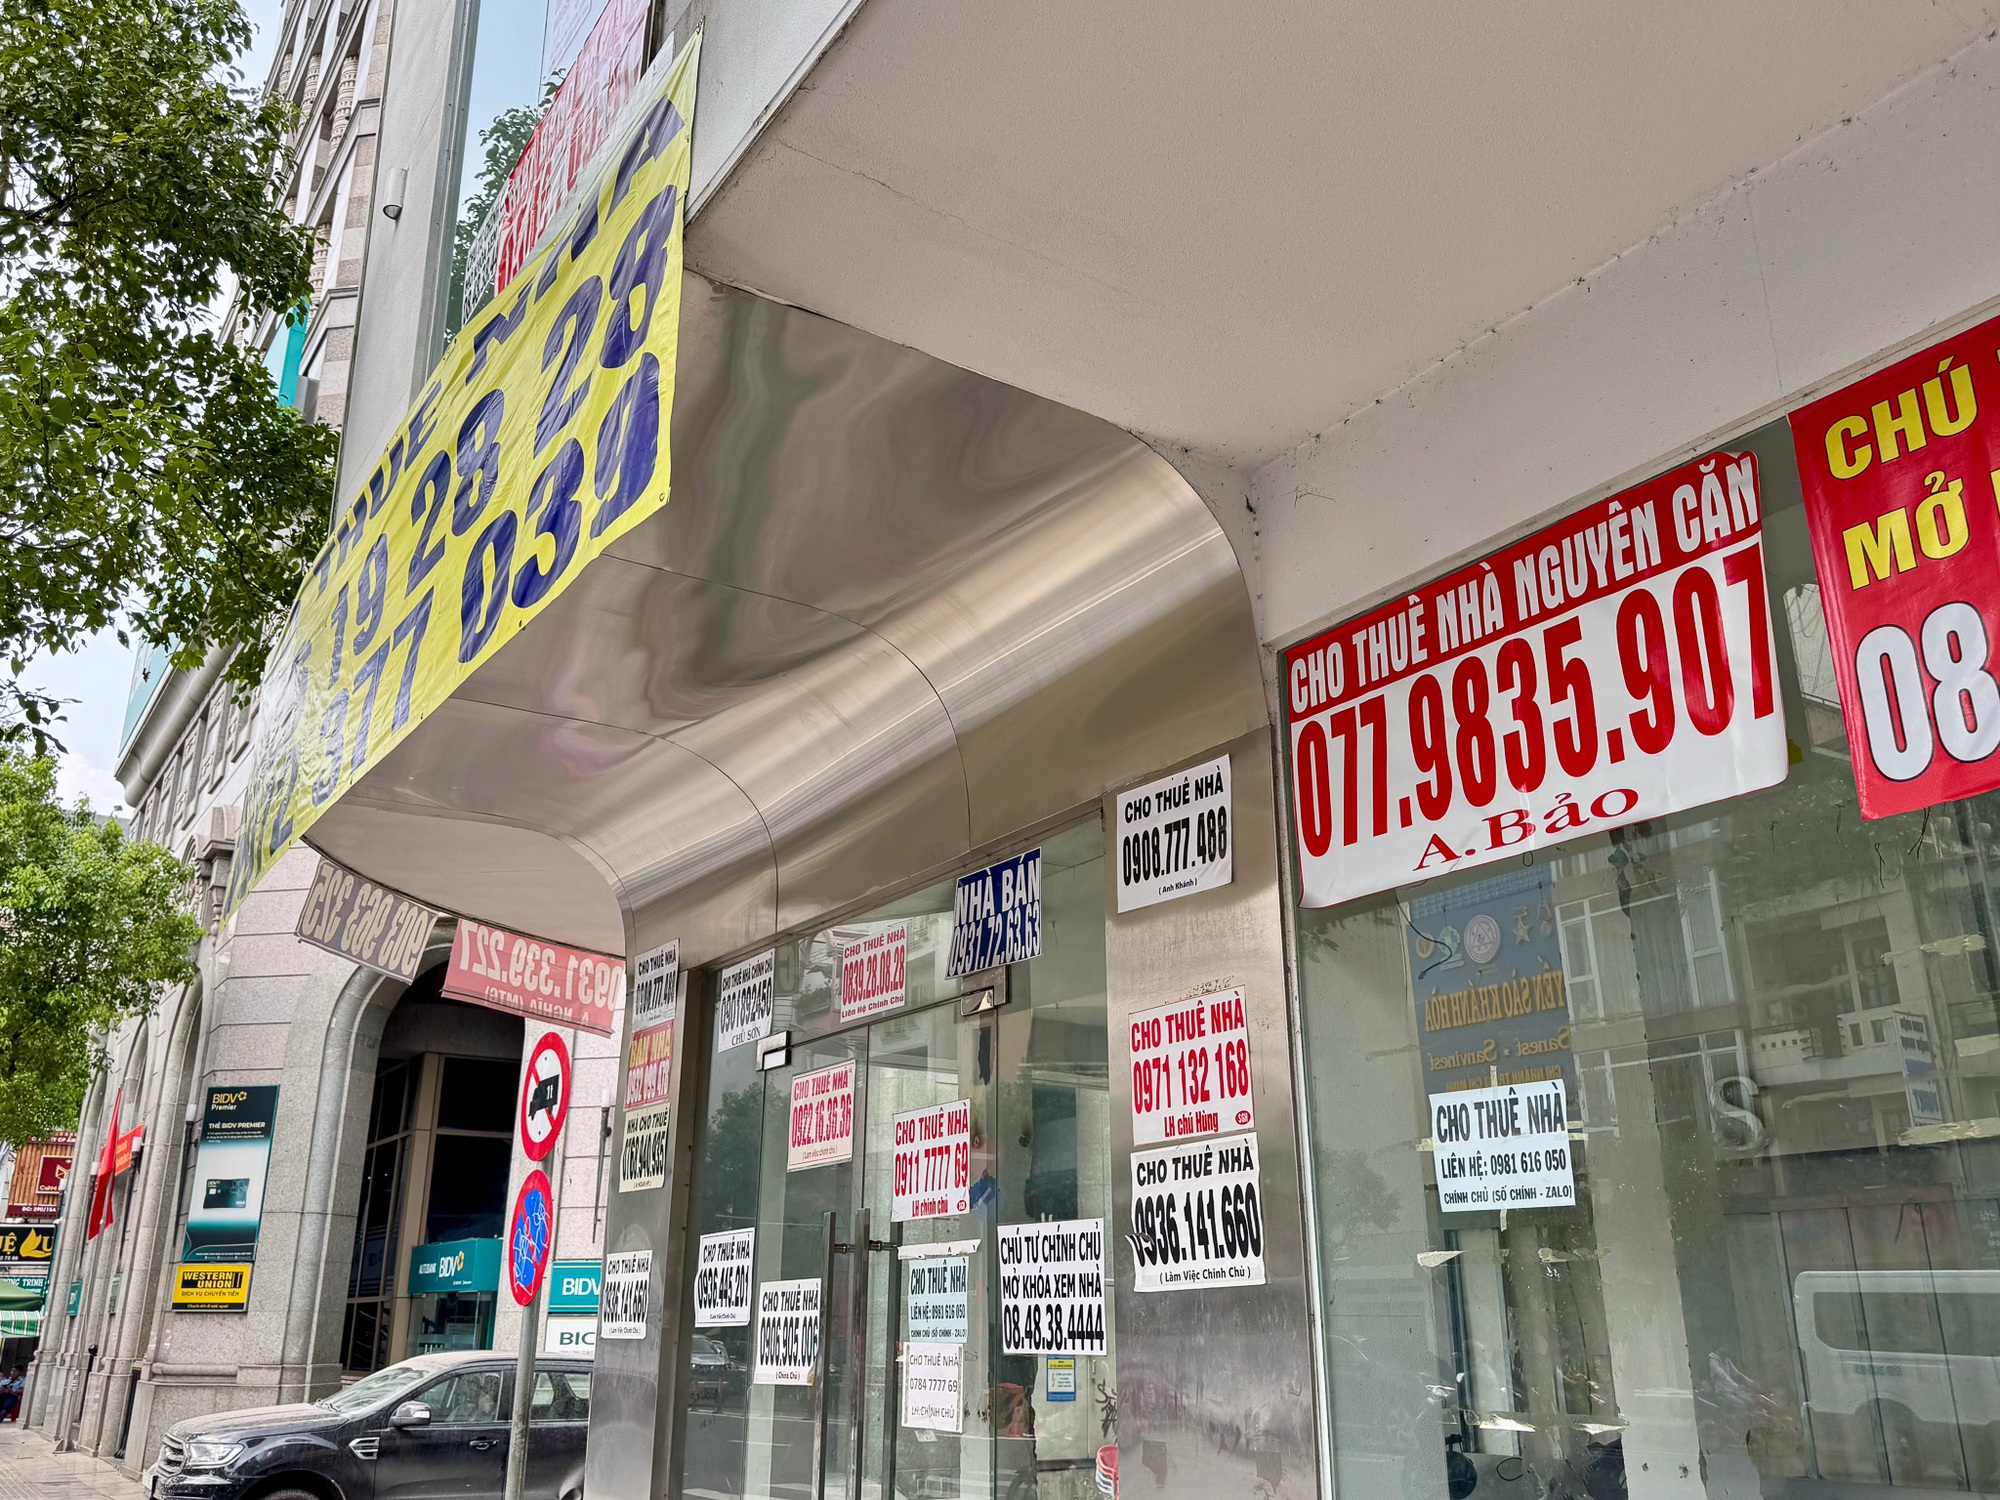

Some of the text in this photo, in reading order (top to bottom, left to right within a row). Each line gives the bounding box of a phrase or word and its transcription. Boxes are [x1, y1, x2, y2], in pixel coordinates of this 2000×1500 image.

[1825, 354, 1979, 480] CHÚ
[1842, 470, 1971, 591] MỞ
[1290, 455, 1760, 714] CHO THUÊ NHÀ NGUYÊN CĂN
[1296, 543, 1775, 858] 077.9835.907
[1125, 765, 1224, 824] CHO THUÊ NHÀ
[1412, 788, 1639, 872] A.Bảo
[955, 854, 1040, 926] NHÀ BÁN
[845, 926, 905, 959] CHO THUÊ NHÀ
[948, 901, 1040, 975] 0931.72.63.63
[843, 945, 905, 1006] 0839.28.08.28
[1131, 991, 1244, 1052] CHO THUÊ NHÀ
[794, 1080, 809, 1101] CHO
[832, 1066, 848, 1091] NHÀ
[1133, 1038, 1249, 1114] 0971 132 168
[213, 1093, 238, 1104] BIDV
[1436, 1082, 1565, 1143] CHO THUÊ NHÀ
[896, 1102, 968, 1146] CHO THUÊ NHÀ
[1164, 1110, 1219, 1137] LH chú Hùng
[895, 1141, 968, 1197] 0911 7777 69
[1137, 1138, 1254, 1186] CHO THUÊ NHÀ
[1441, 1148, 1567, 1181] LIÊN HỆ: 0981 616 050
[1444, 1184, 1572, 1204] CHÍNH CHỦ (SỐ CHÍNH ZALO)
[703, 1244, 716, 1263] CHO
[736, 1234, 750, 1259] NHÀ
[1001, 1222, 1101, 1265] CHÚ TƯ CHÍNH CHỦ
[184, 1272, 233, 1280] WESTERN
[197, 1280, 232, 1288] UNION
[439, 1256, 459, 1277] BIDV
[911, 1258, 966, 1295] CHO THUÊ NHÀ
[1002, 1264, 1102, 1299] MỞ KHÓA XEM NHÀ
[1203, 1267, 1226, 1280] Chính
[763, 1283, 818, 1312] CHO THUÊ NHÀ
[1003, 1303, 1104, 1351] 08.48.38.4444
[909, 1353, 958, 1367] CHO THUÊ NHÀ
[909, 1378, 957, 1393] 0784 7777 69
